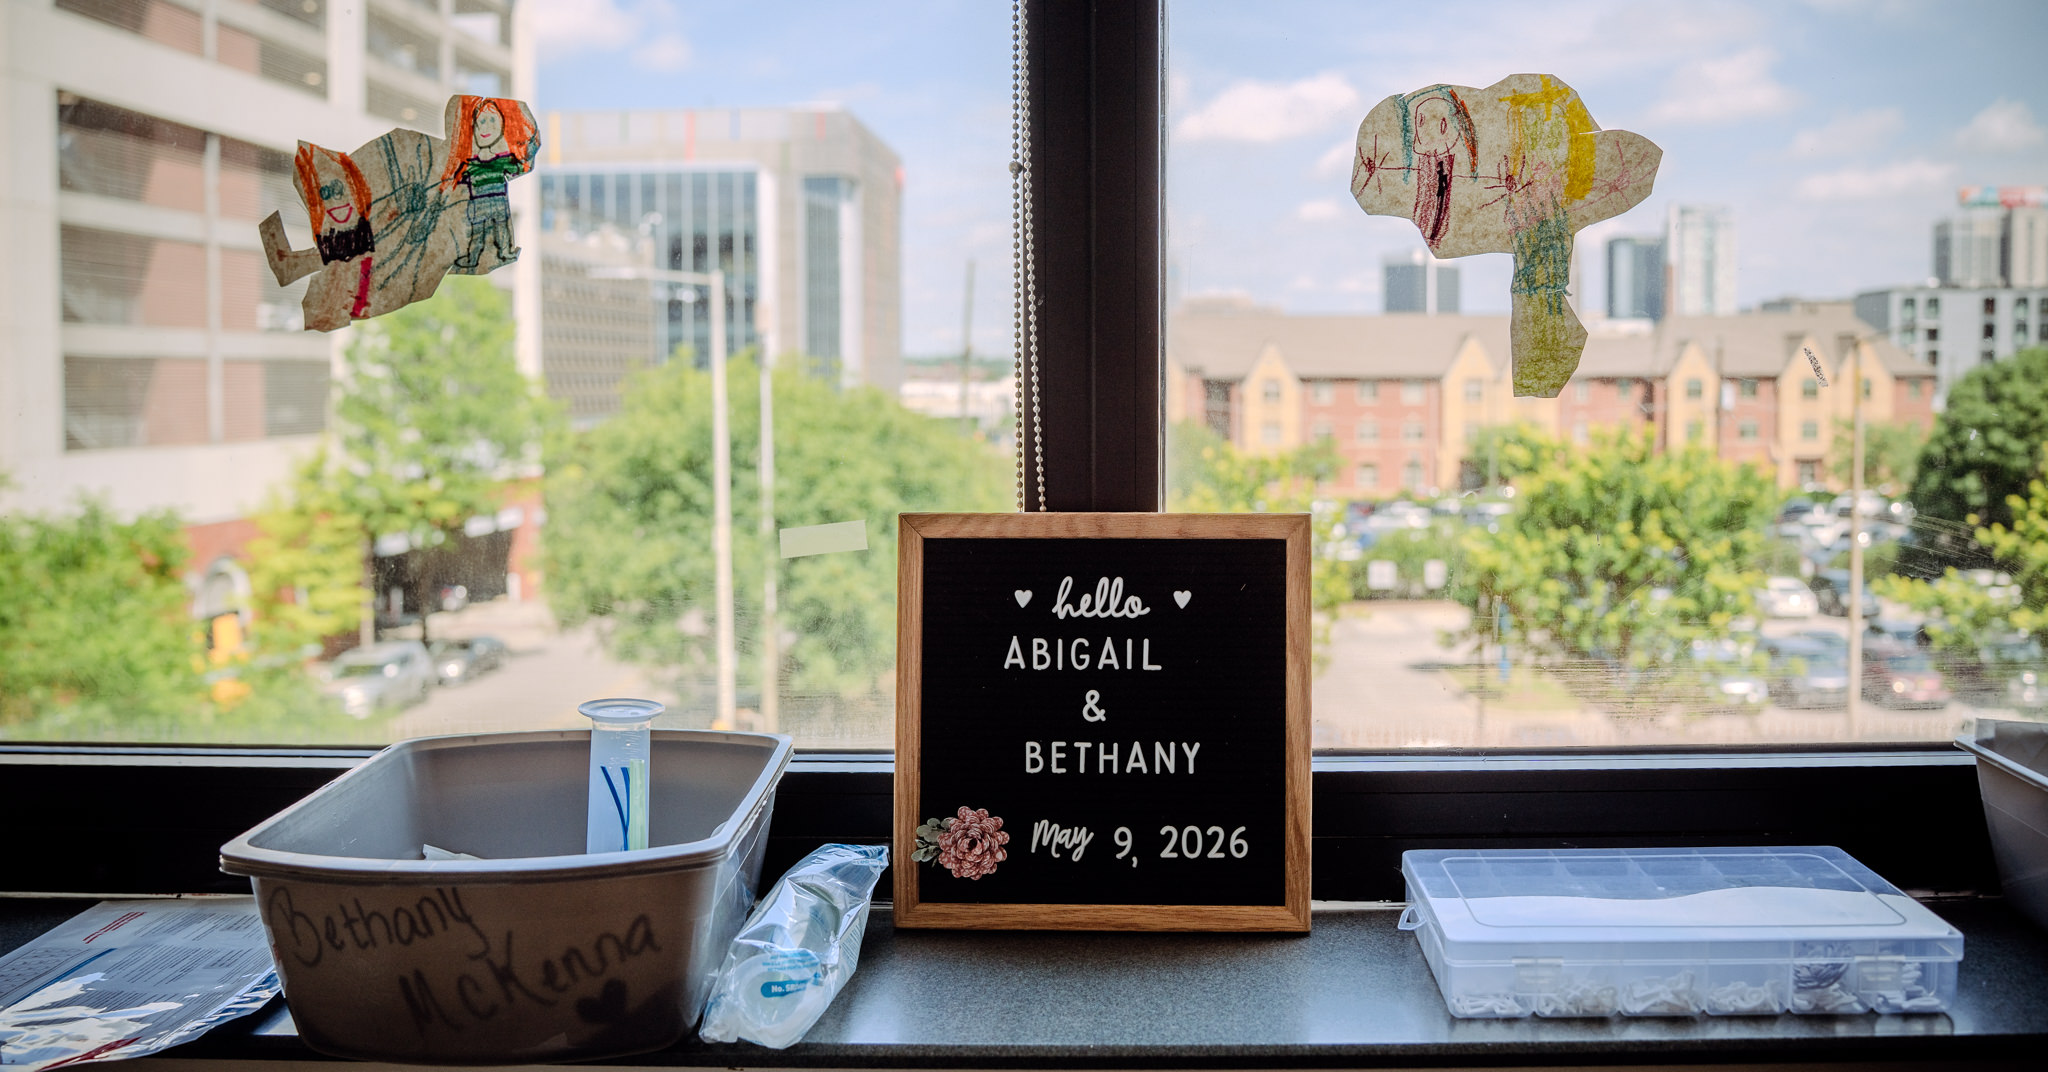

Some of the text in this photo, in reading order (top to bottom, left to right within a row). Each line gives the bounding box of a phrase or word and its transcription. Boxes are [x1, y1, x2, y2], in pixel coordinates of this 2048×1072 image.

[1052, 576, 1151, 620] hello
[1004, 636, 1162, 671] ABIGAIL
[1083, 690, 1107, 723] &
[1025, 741, 1201, 775] BETHANY
[1031, 819, 1249, 868] May 9, 2026
[268, 886, 490, 968] Bethany
[398, 914, 662, 1034] McKenna
